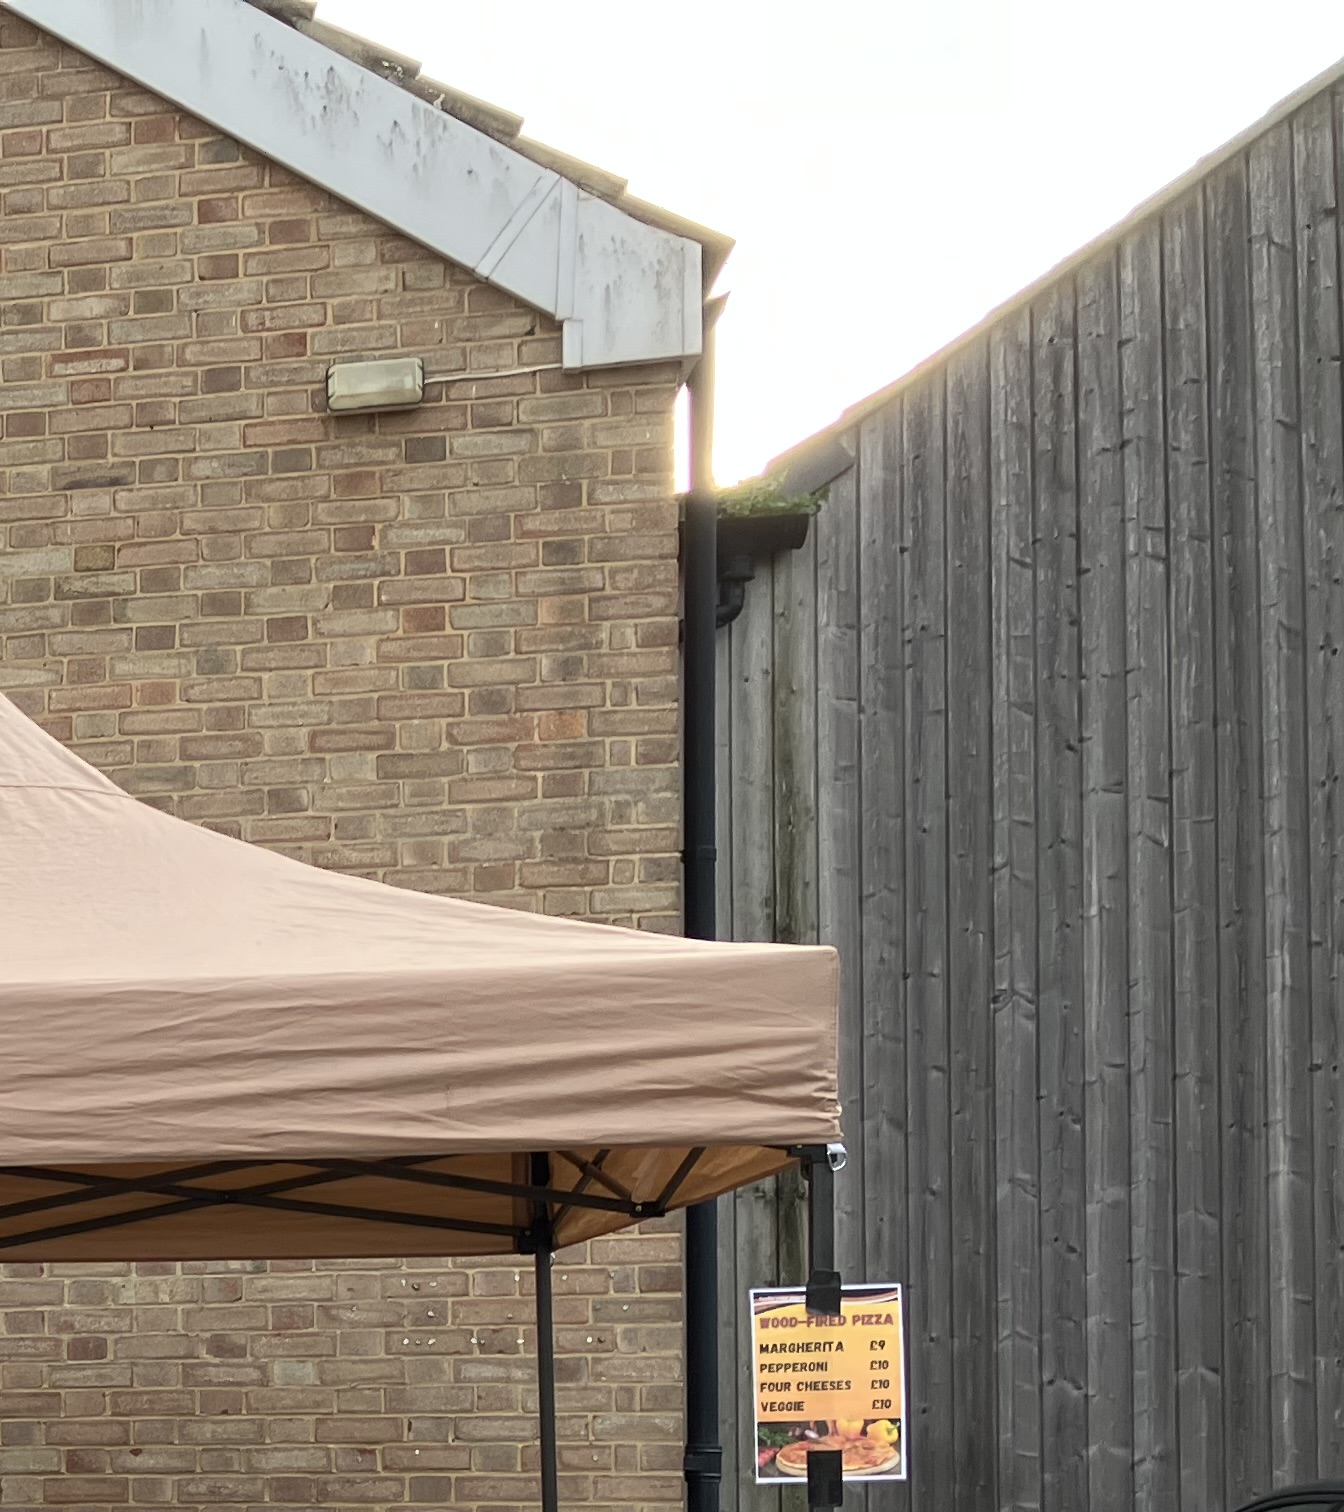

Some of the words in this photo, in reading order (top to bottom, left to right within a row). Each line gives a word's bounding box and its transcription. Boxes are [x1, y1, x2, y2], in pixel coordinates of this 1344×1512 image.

[759, 1314, 847, 1329] WOOD-FIRED
[852, 1313, 894, 1326] PIZZA
[759, 1341, 844, 1354] MARGHERITA
[869, 1340, 886, 1351] £9
[759, 1361, 828, 1373] PEPPERONI
[869, 1360, 889, 1371] £10
[759, 1381, 791, 1393] FOUR
[796, 1380, 852, 1392] CHEESES
[870, 1379, 890, 1390] £10
[761, 1401, 805, 1412] VEGGIE
[871, 1399, 892, 1410] £10
